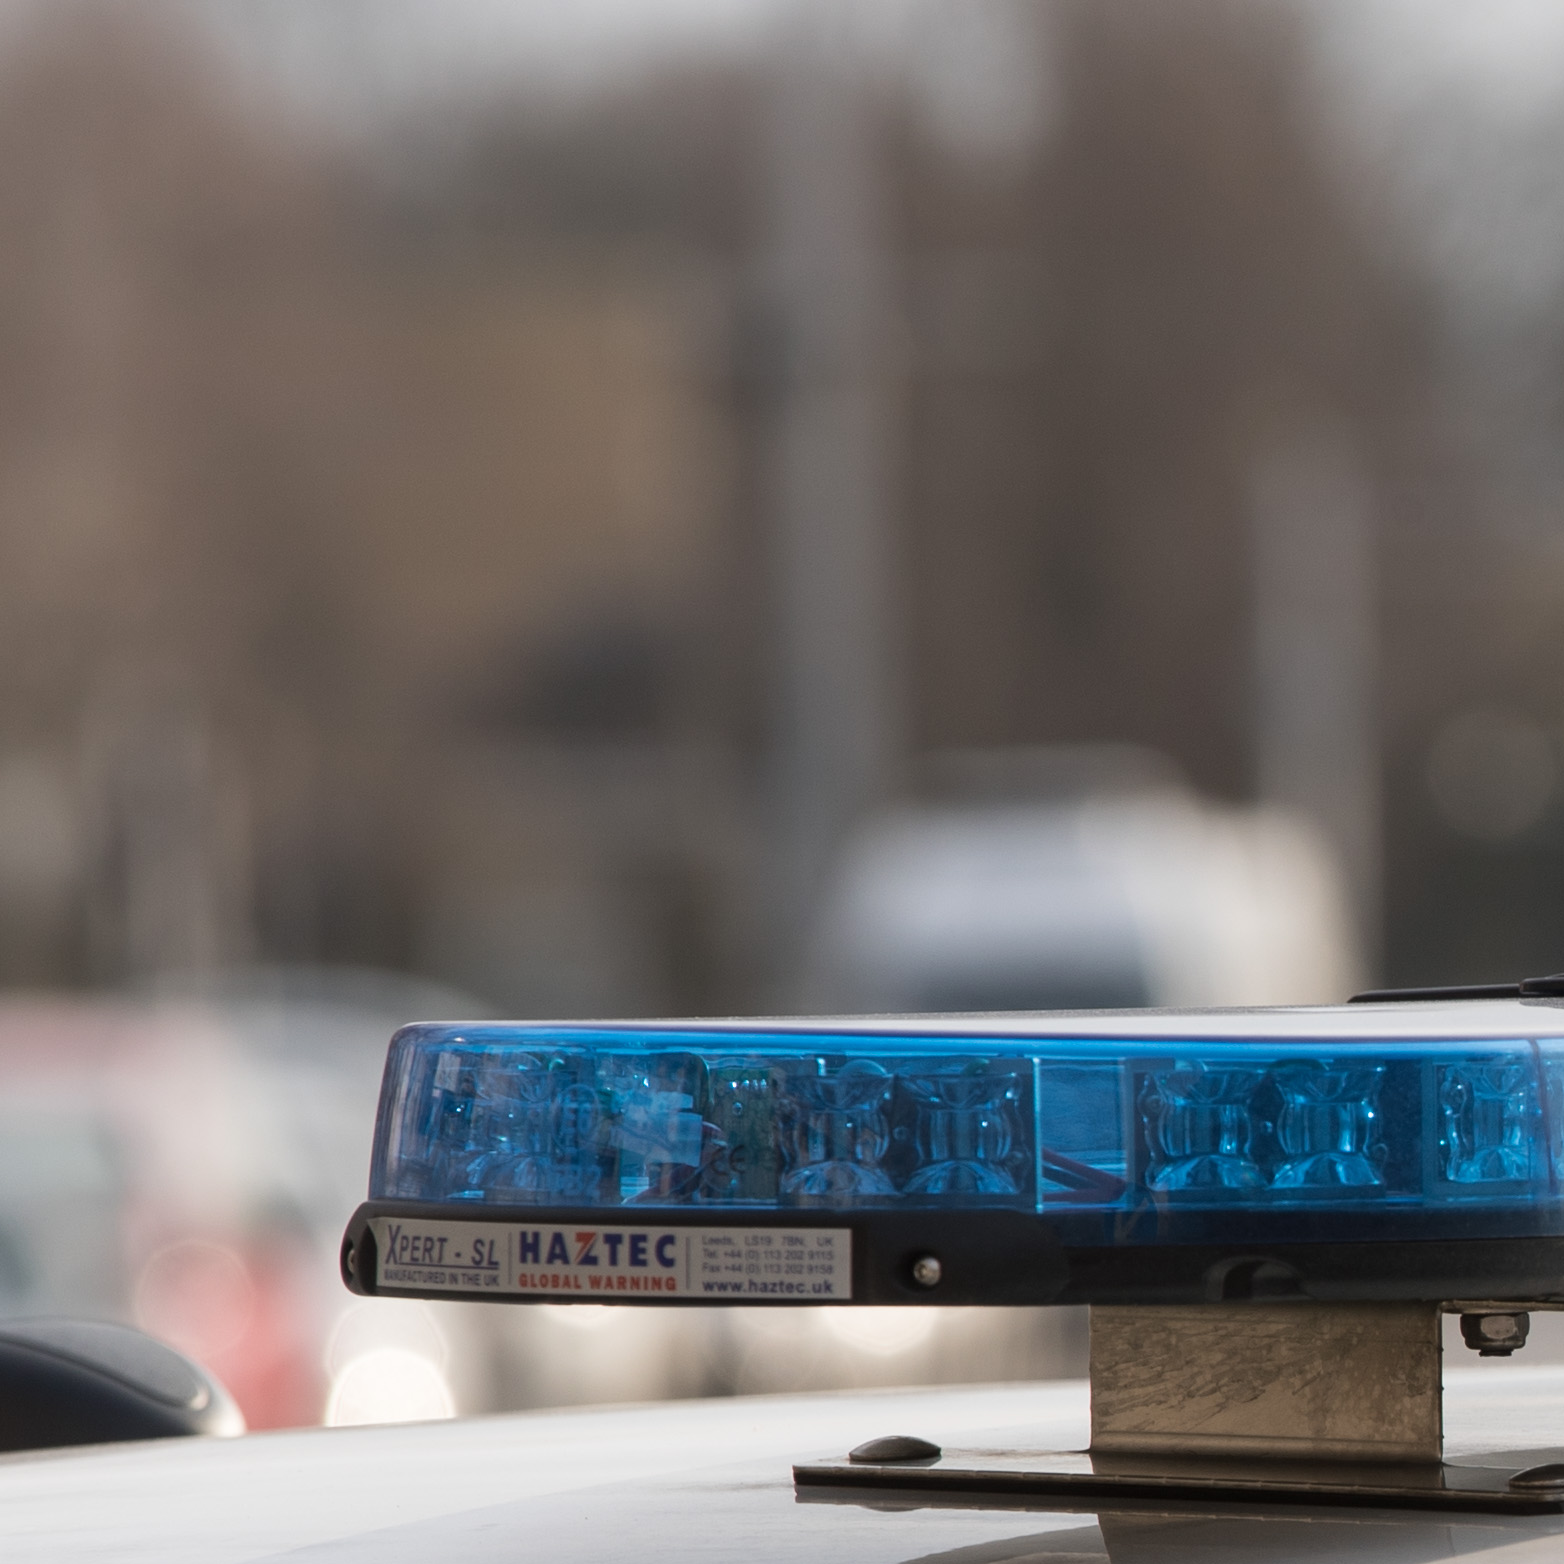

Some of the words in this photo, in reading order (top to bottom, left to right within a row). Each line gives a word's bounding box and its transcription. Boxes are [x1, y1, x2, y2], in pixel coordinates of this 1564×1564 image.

[816, 1235, 834, 1247] UK
[471, 1238, 500, 1267] SL
[519, 1231, 676, 1268] HAZTEC
[723, 1249, 742, 1259] +44
[744, 1249, 760, 1261] (0)
[763, 1249, 782, 1260] 113
[702, 1261, 721, 1273] Fax
[723, 1263, 743, 1273] +44
[744, 1262, 762, 1276] (0)
[763, 1263, 782, 1275] 113
[448, 1272, 459, 1286] IN
[461, 1273, 482, 1287] THE
[483, 1273, 501, 1287] UK
[518, 1272, 583, 1290] GLOBAL
[587, 1274, 679, 1292] WARNING
[702, 1278, 834, 1293] www.haztec.uk
